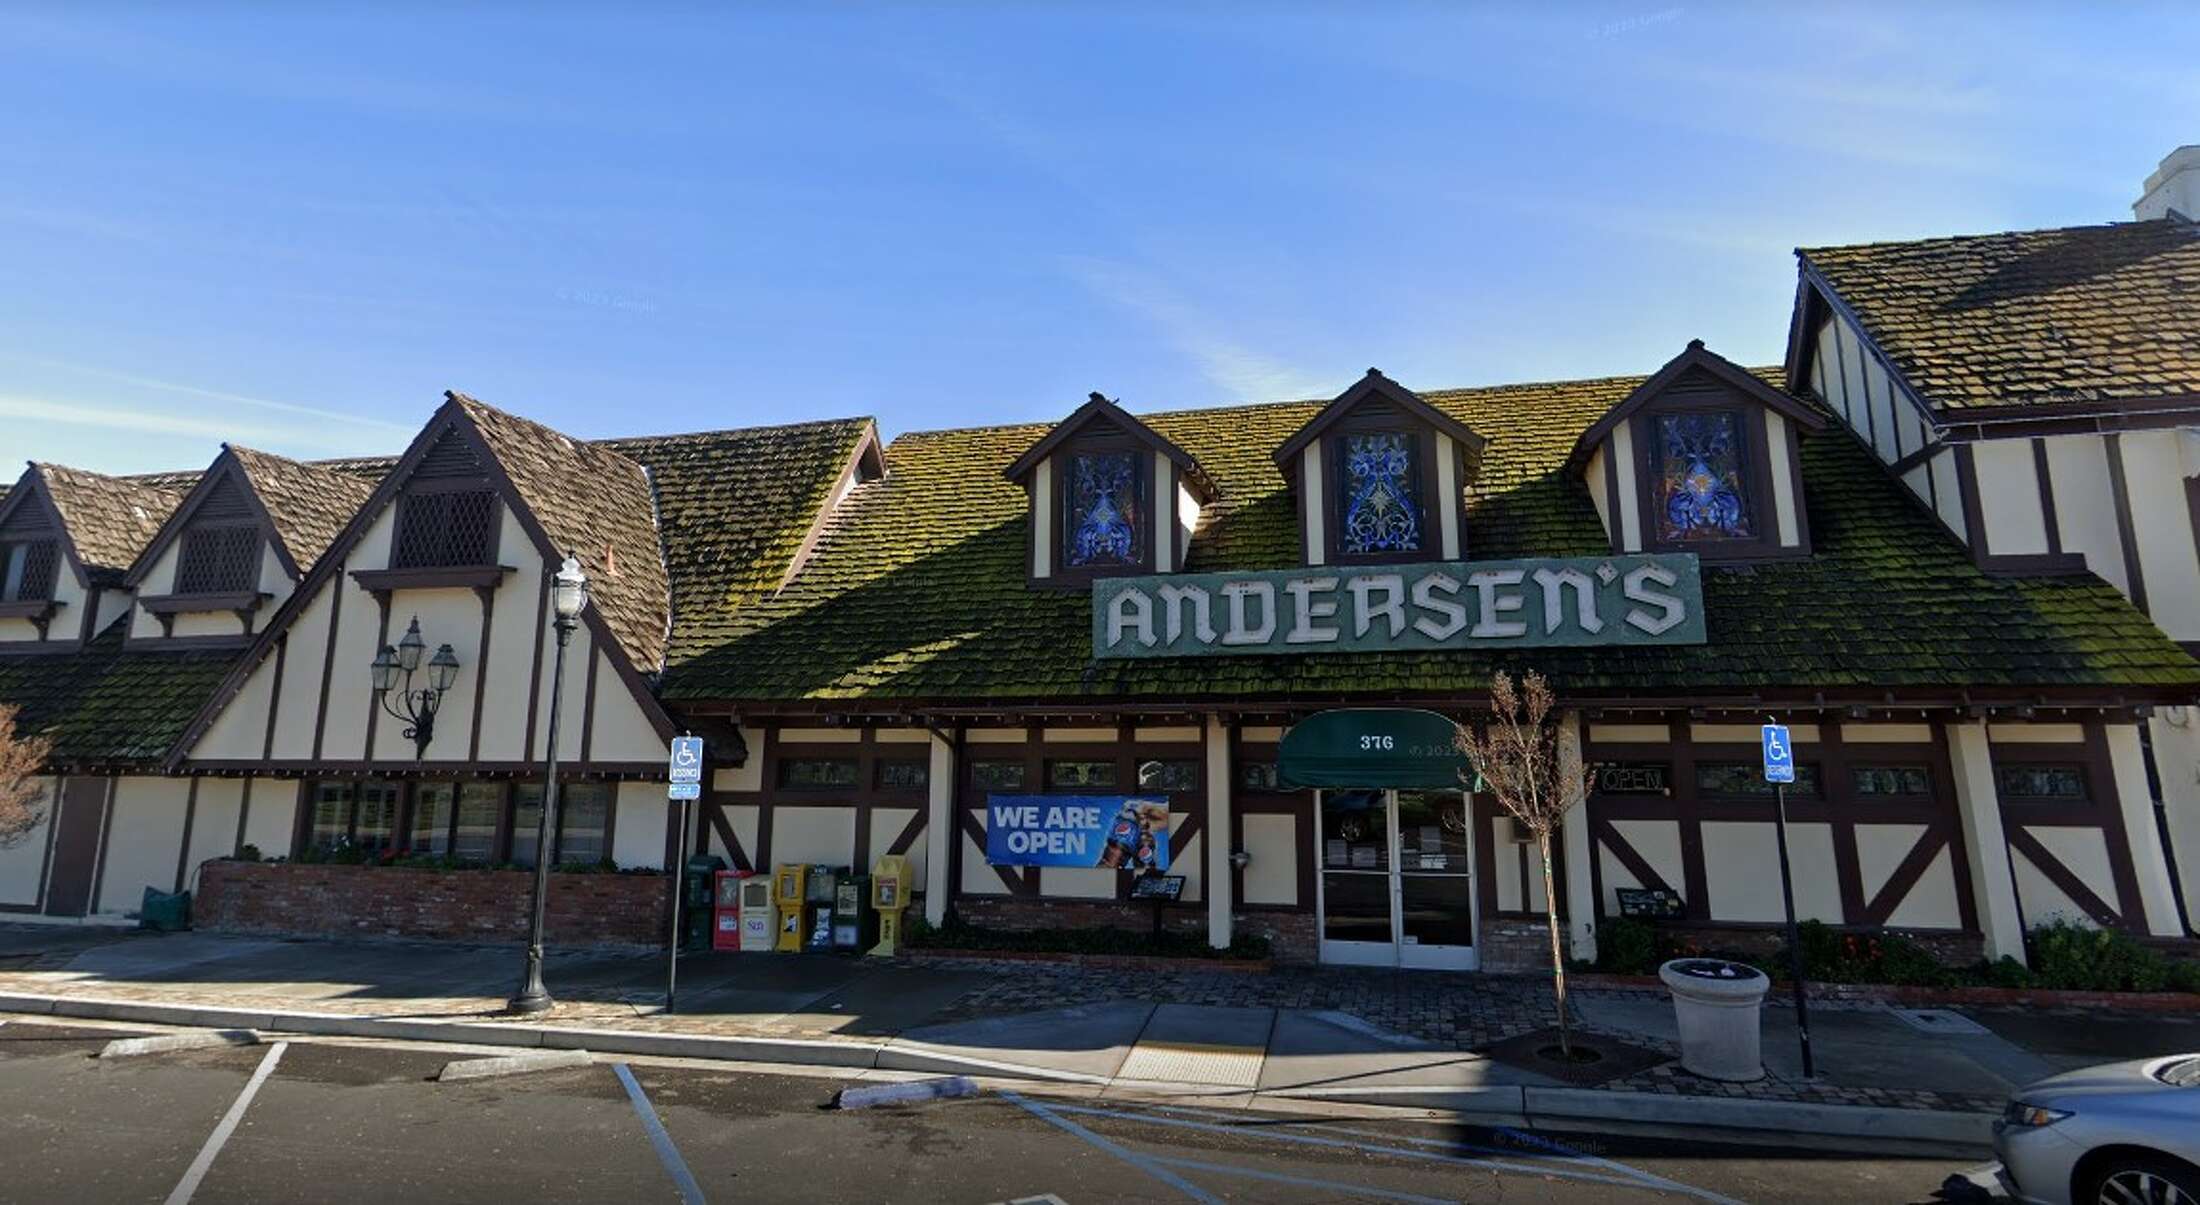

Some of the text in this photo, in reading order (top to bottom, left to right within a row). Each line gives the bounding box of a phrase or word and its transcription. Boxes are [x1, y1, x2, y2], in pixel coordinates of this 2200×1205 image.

[1360, 735, 1394, 751] 376
[1602, 768, 1663, 790] OPEN
[994, 806, 1101, 829] WE ARE
[1007, 831, 1087, 855] OPEN
